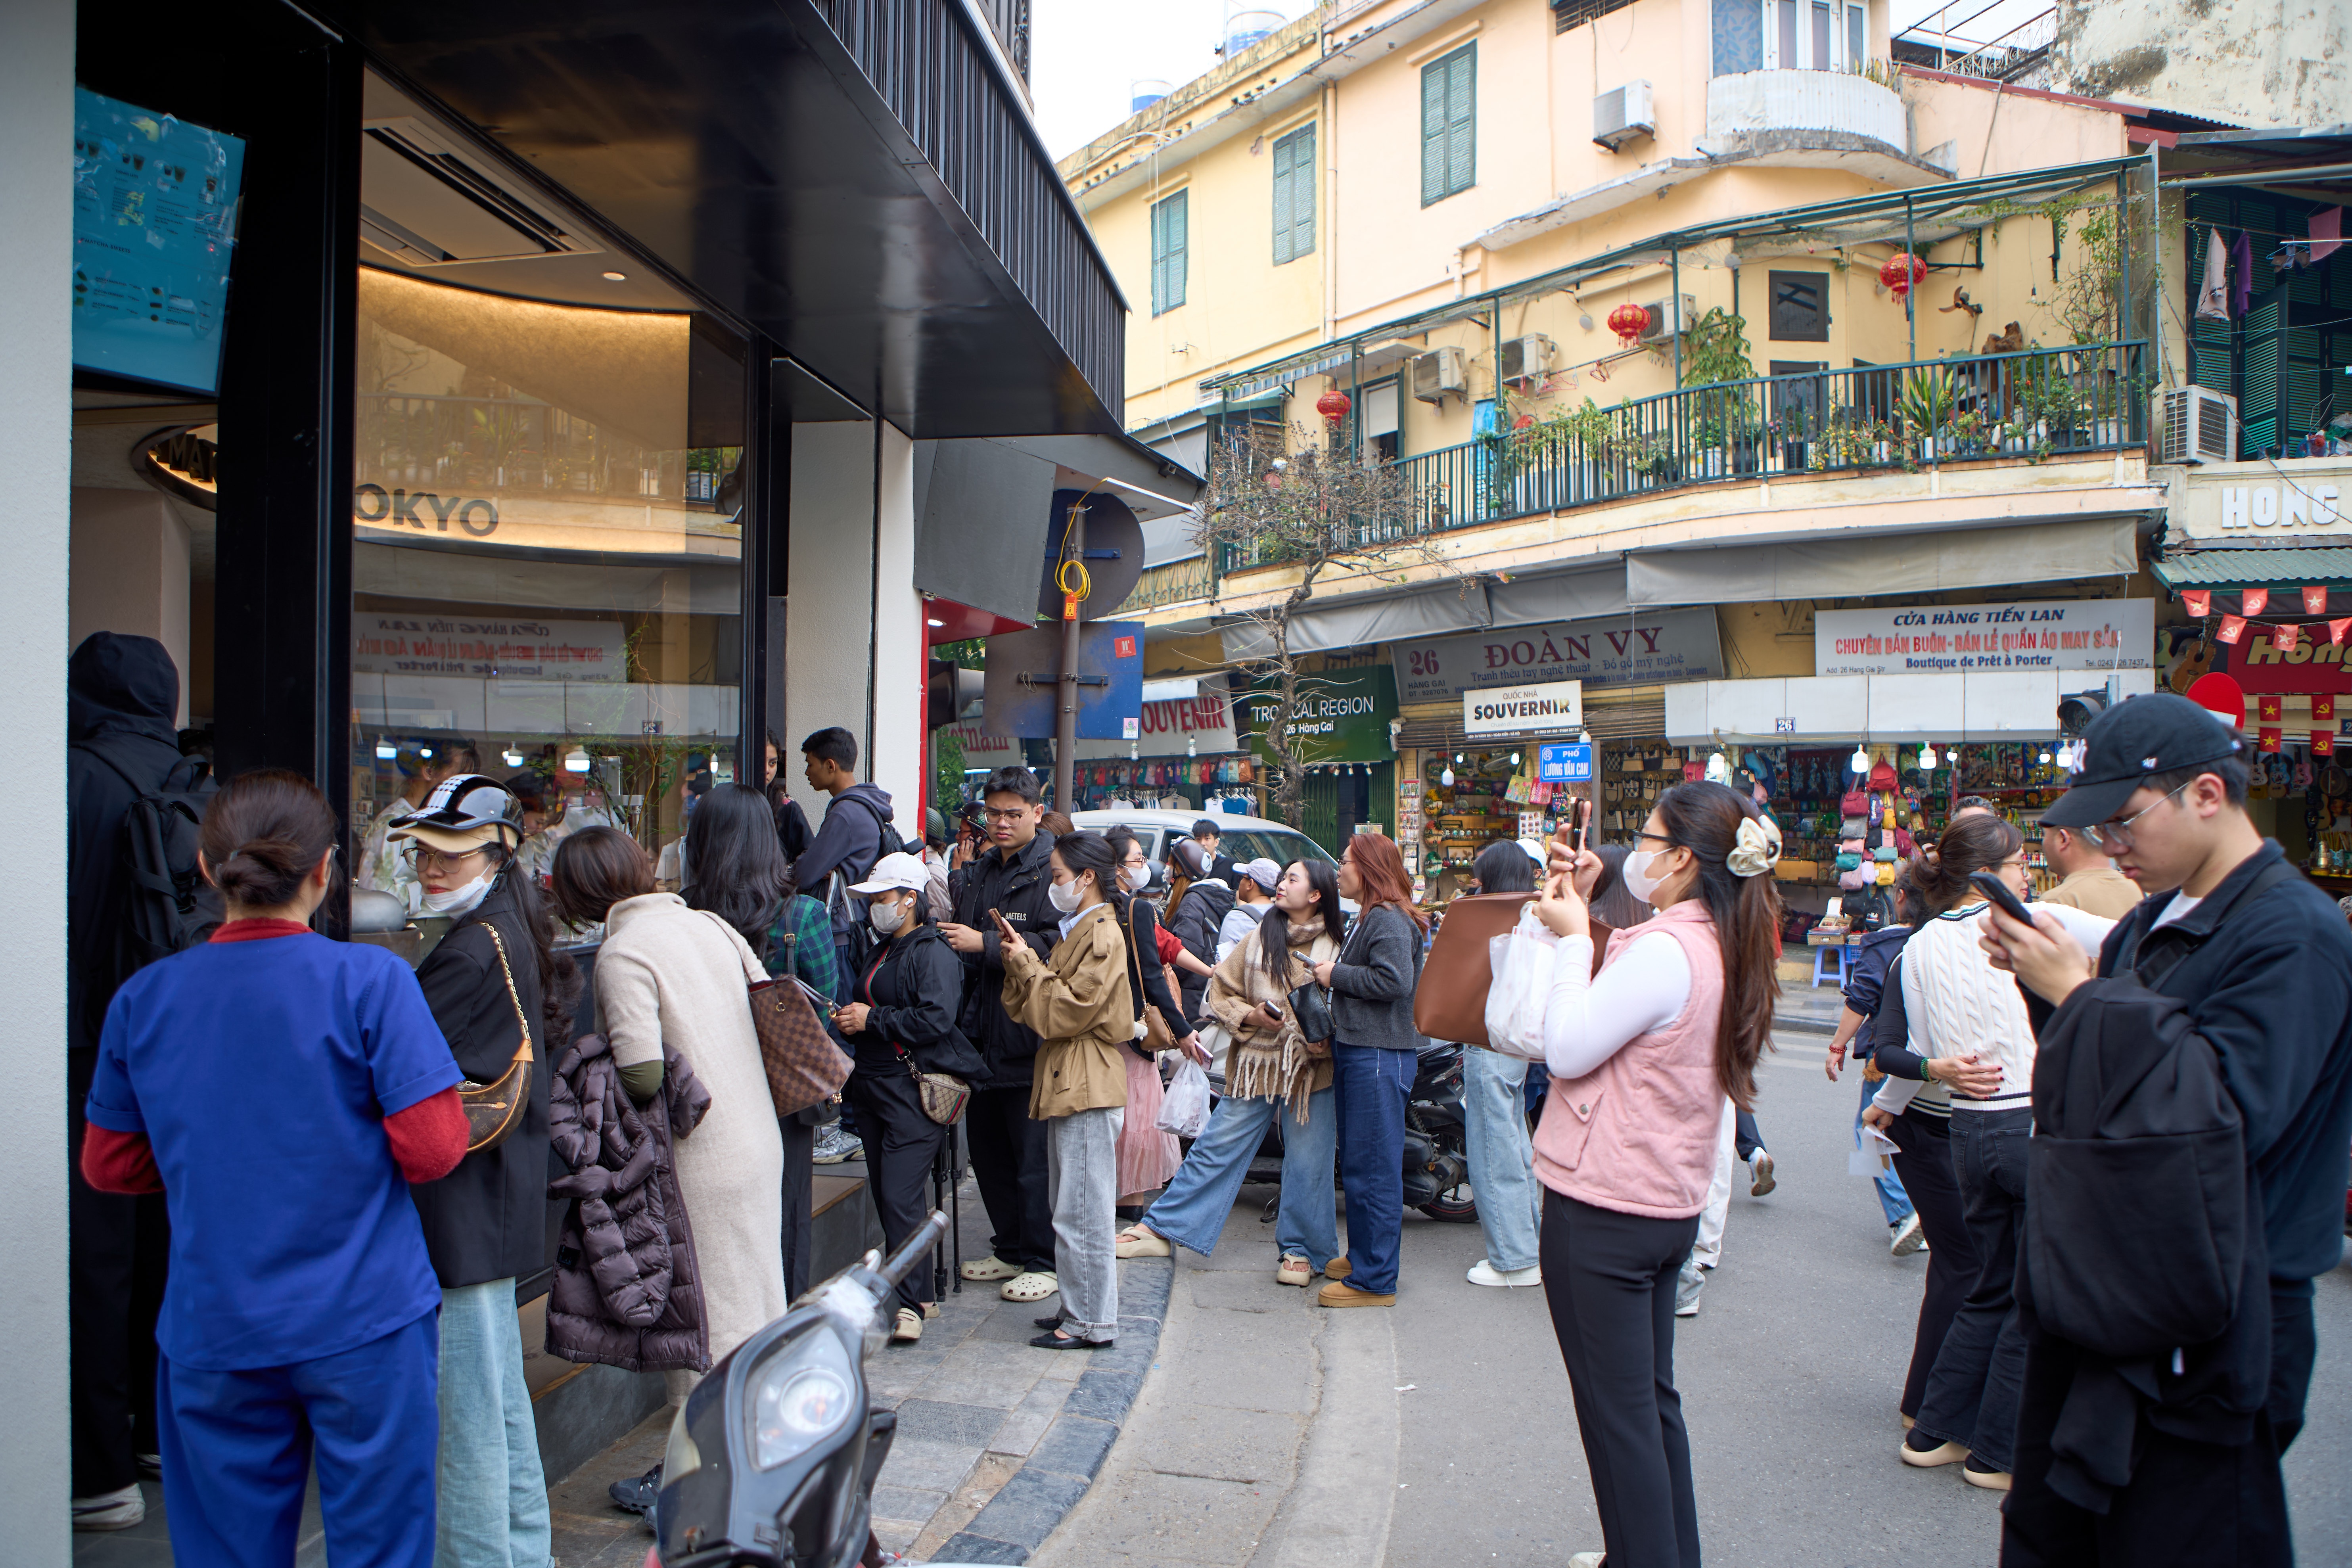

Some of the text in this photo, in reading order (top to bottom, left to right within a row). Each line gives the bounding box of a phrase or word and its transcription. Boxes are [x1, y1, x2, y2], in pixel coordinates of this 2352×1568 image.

[85, 238, 131, 253] MATCHA SWEETS
[2222, 484, 2338, 529] HONG
[1894, 606, 2065, 625] CỬA HÀNG TIẾN LAN
[1484, 626, 1663, 669] ĐOÀN VY
[1836, 633, 1882, 654] CHUYÊN
[1885, 632, 1910, 654] BÁN
[1913, 631, 1947, 652] BUÔN
[1955, 630, 1981, 651] BÁN
[2040, 628, 2058, 649] ÁO
[2062, 630, 2091, 649] MAY
[1409, 649, 1440, 675] 26
[1470, 671, 1498, 682] Tranh
[1603, 657, 1617, 670] Đồ
[1906, 654, 2053, 670] Boutique de Prêt à Porter
[1408, 680, 1430, 689] HÀNG
[1503, 689, 1522, 700] QUỐC
[1141, 696, 1227, 733] OUVENIR
[1251, 696, 1374, 722] TROCAL REGION
[1474, 698, 1571, 720] SOUVERNIR
[1299, 723, 1319, 734] Hàng
[1321, 720, 1334, 731] Gai
[1778, 719, 1792, 731] 26
[1562, 748, 1580, 757] PHỐ
[1545, 760, 1589, 776] LƯƠNG VĂN CAN
[1005, 912, 1027, 921] BAETELS
